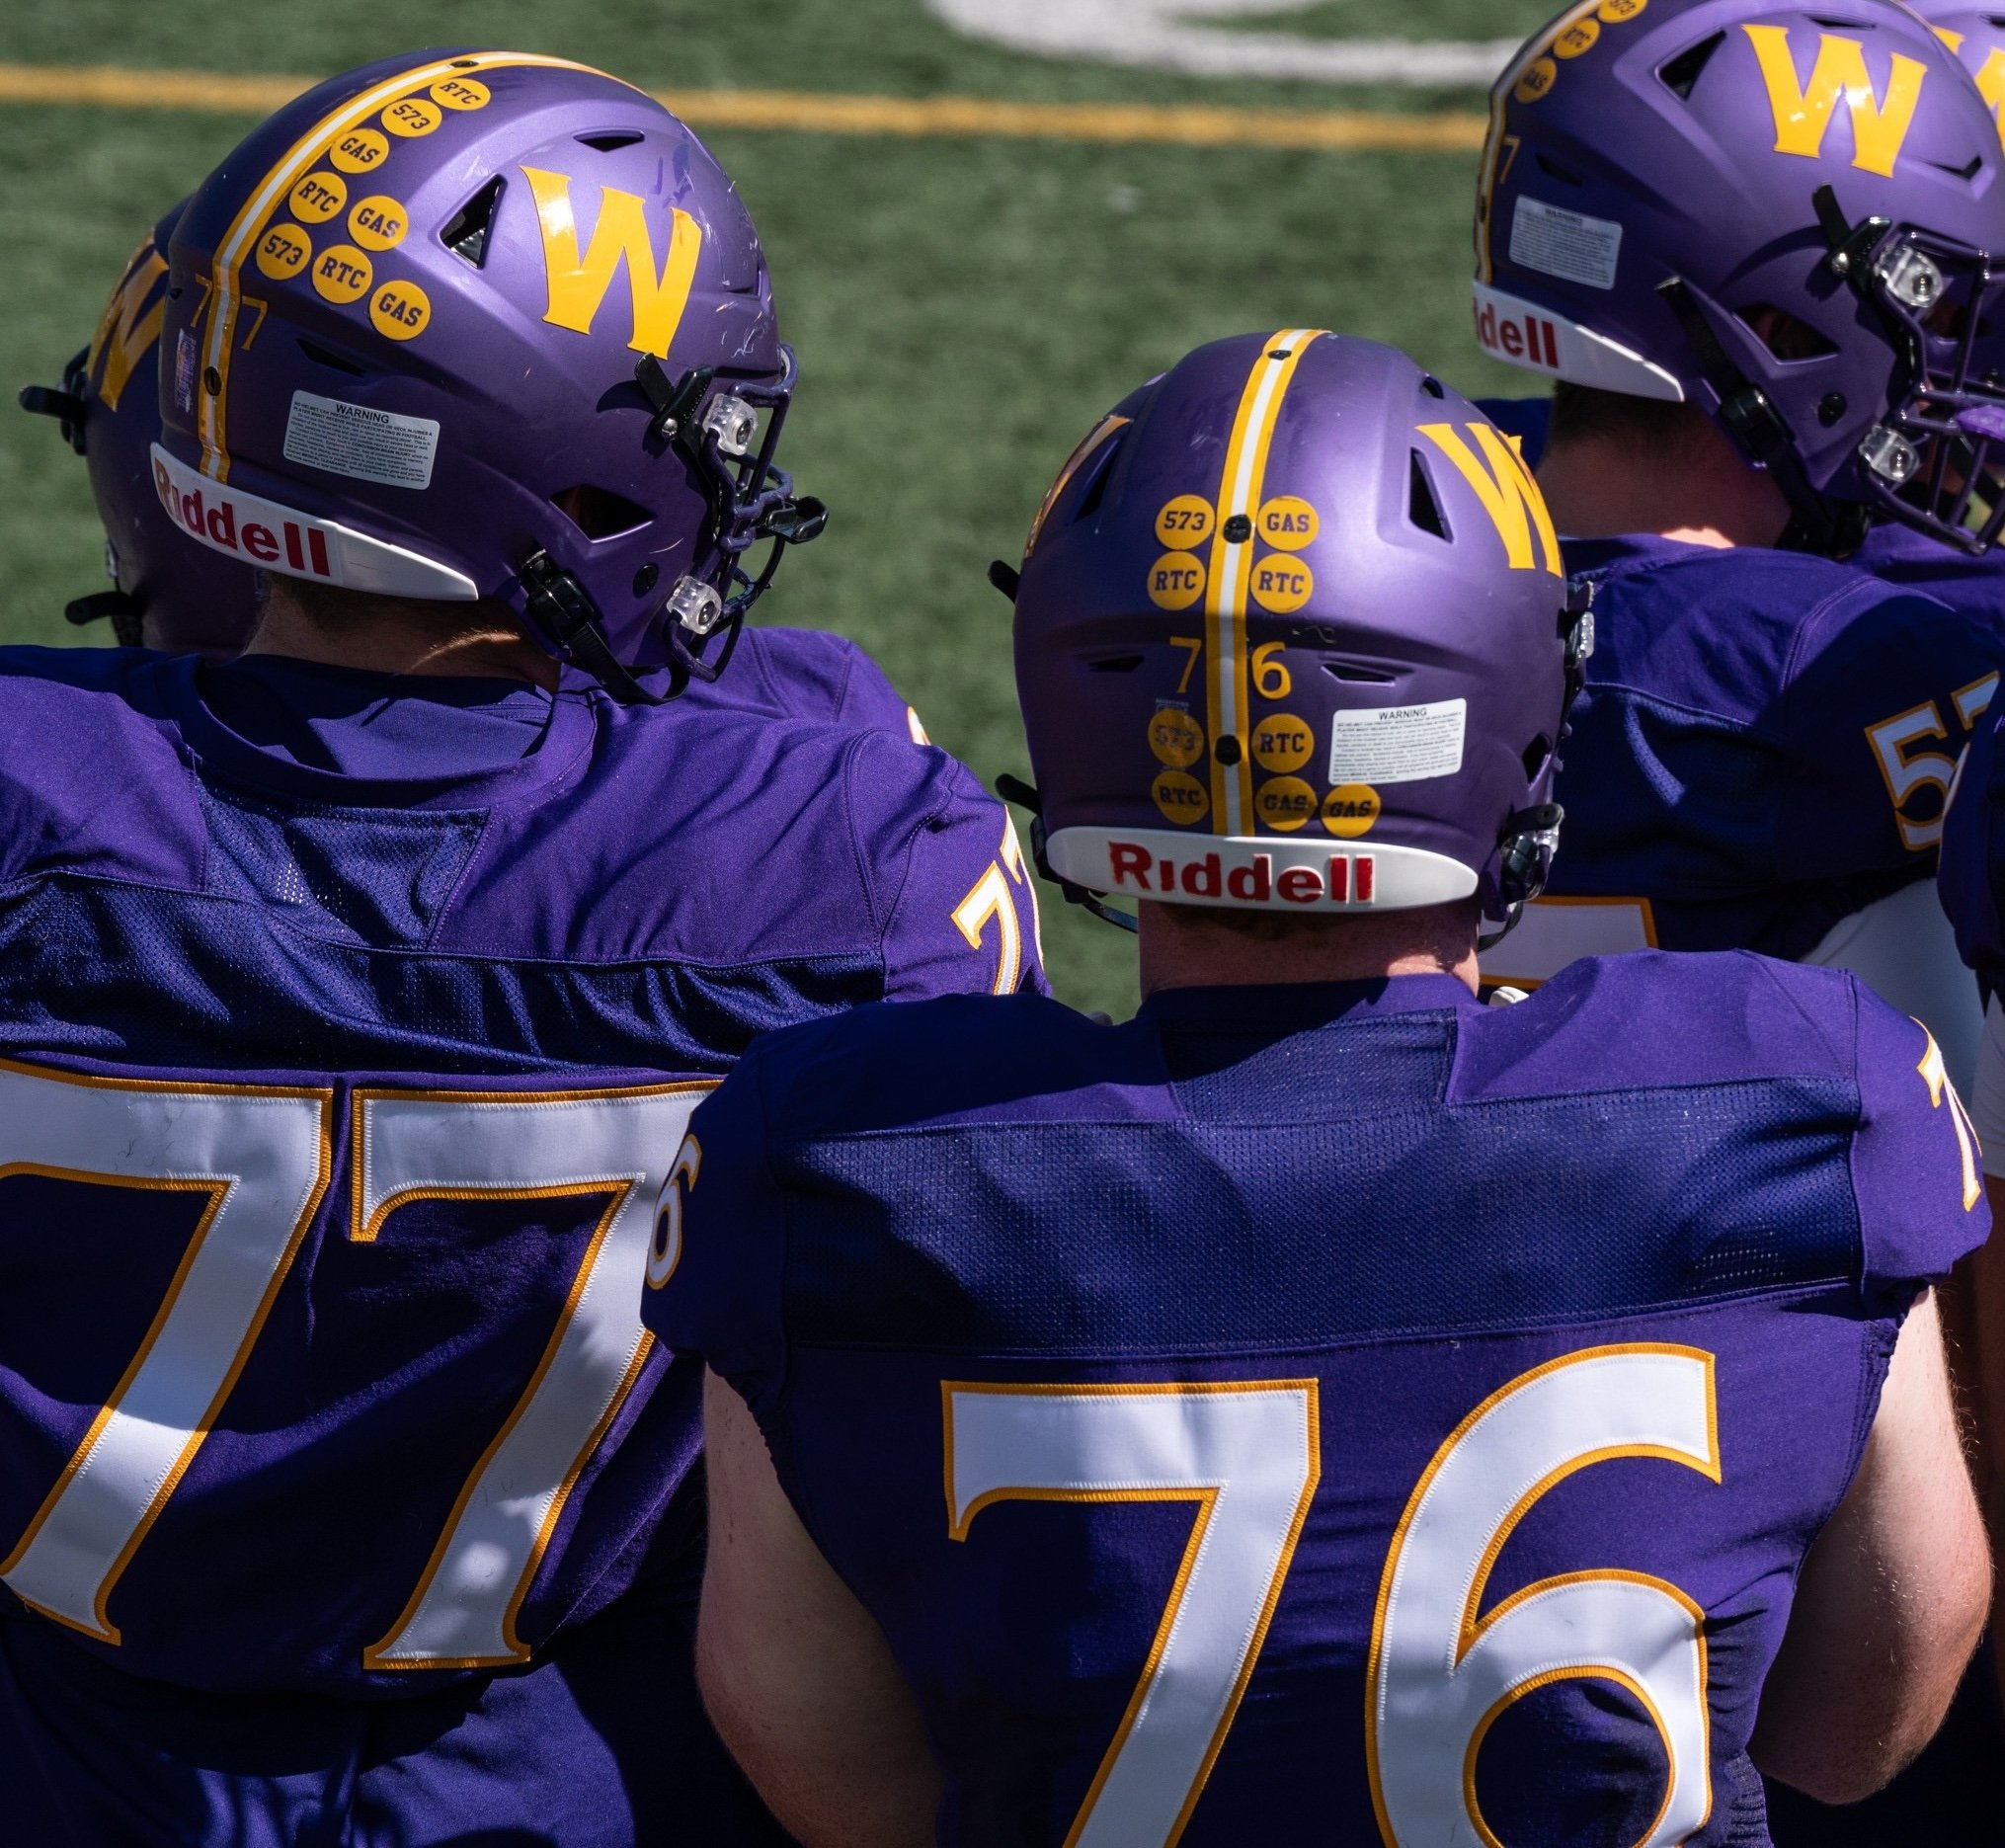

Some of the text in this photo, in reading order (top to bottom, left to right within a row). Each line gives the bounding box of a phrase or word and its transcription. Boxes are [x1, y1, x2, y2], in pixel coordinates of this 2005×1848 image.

[441, 82, 481, 104] RTC
[1740, 24, 1928, 178] W
[392, 103, 430, 129] 573
[340, 137, 379, 162] GAS
[298, 181, 339, 212] RTC
[357, 207, 401, 240] GAS
[264, 236, 303, 267] 573
[519, 165, 702, 361] W
[320, 257, 365, 290] RTC
[377, 293, 423, 327] GAS
[1473, 296, 1559, 369] dell
[336, 404, 389, 425] WARNING
[154, 457, 330, 577] Riddell
[1163, 511, 1206, 530] 573
[1266, 514, 1310, 532] GAS
[1155, 570, 1197, 591] RTC
[1258, 570, 1304, 595] RTC
[1379, 707, 1427, 720] WARNING
[1258, 733, 1305, 754] RTC
[1159, 784, 1201, 806] RTC
[1263, 794, 1308, 812] GAS
[1328, 800, 1372, 818] GAS
[1108, 841, 1375, 904] Riddell
[645, 1133, 703, 1290] 6
[0, 1060, 724, 1669] 77
[941, 1341, 1722, 1848] 76
